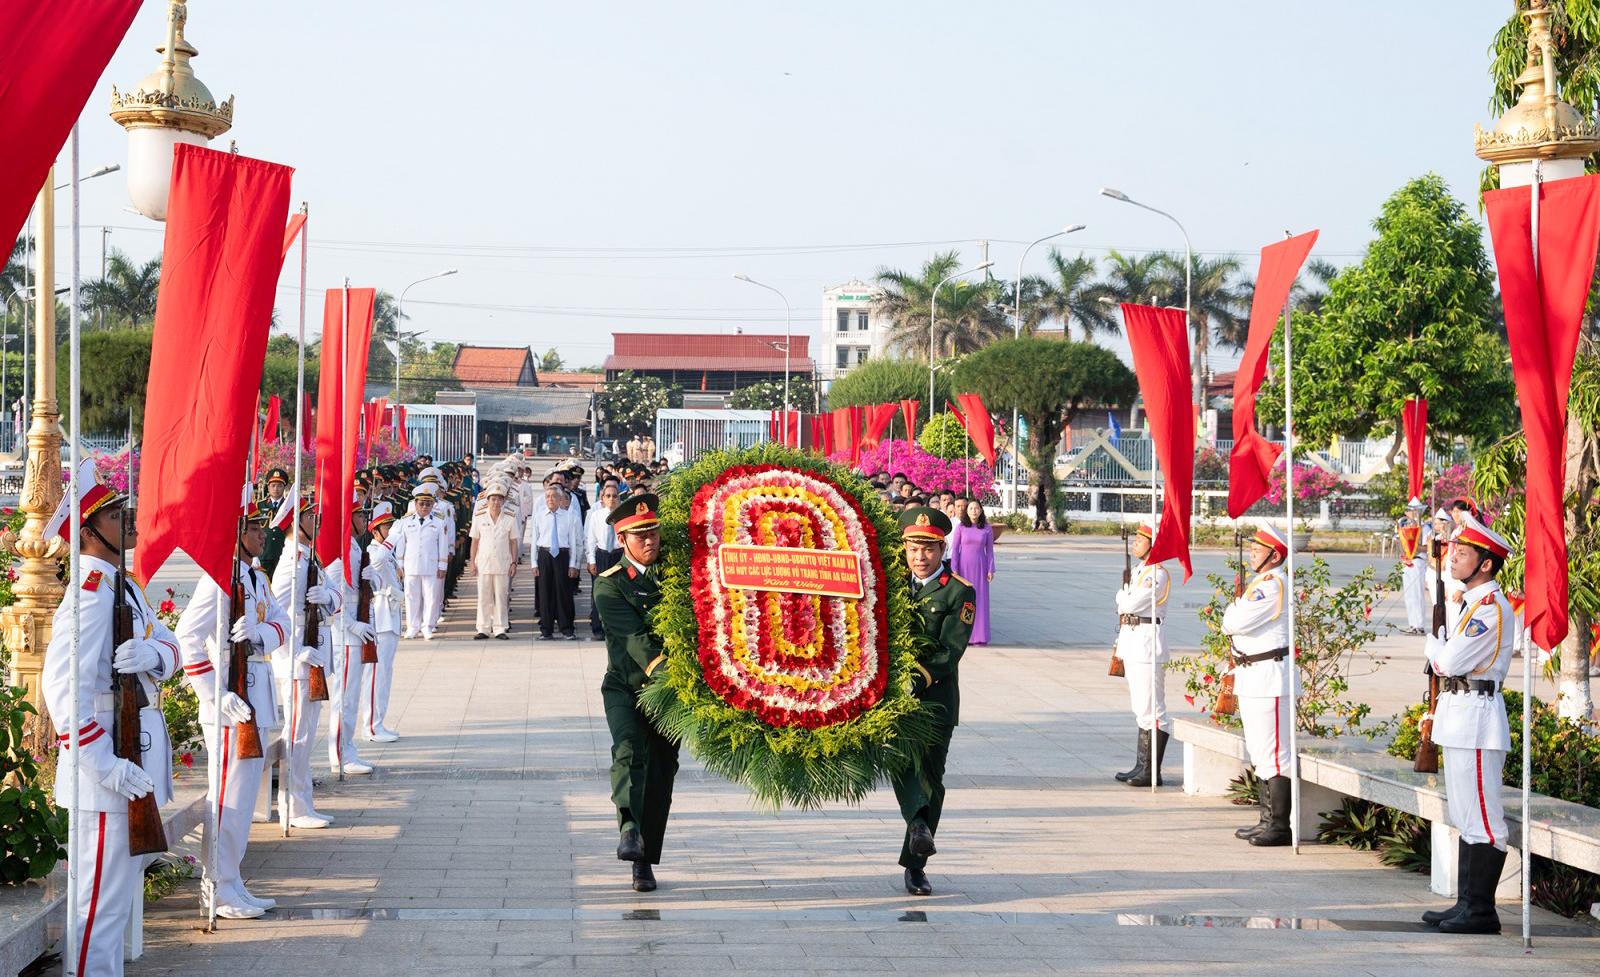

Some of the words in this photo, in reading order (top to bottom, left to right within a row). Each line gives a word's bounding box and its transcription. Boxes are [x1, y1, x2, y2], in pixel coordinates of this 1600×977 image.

[723, 549, 738, 563] TỈNH
[817, 554, 831, 568] VIỆT
[831, 556, 846, 569] NAM
[846, 556, 855, 570] VÀ
[725, 563, 735, 575] CHỈ
[736, 566, 747, 576] HUY
[748, 565, 760, 576] CÁC
[761, 565, 772, 578] LỰC
[772, 565, 791, 578] LƯỢNG
[791, 565, 800, 577] VŨ
[800, 567, 818, 580] TRANG
[818, 567, 833, 580] TỈNH
[833, 571, 841, 582] AN
[841, 571, 857, 584] GIANG
